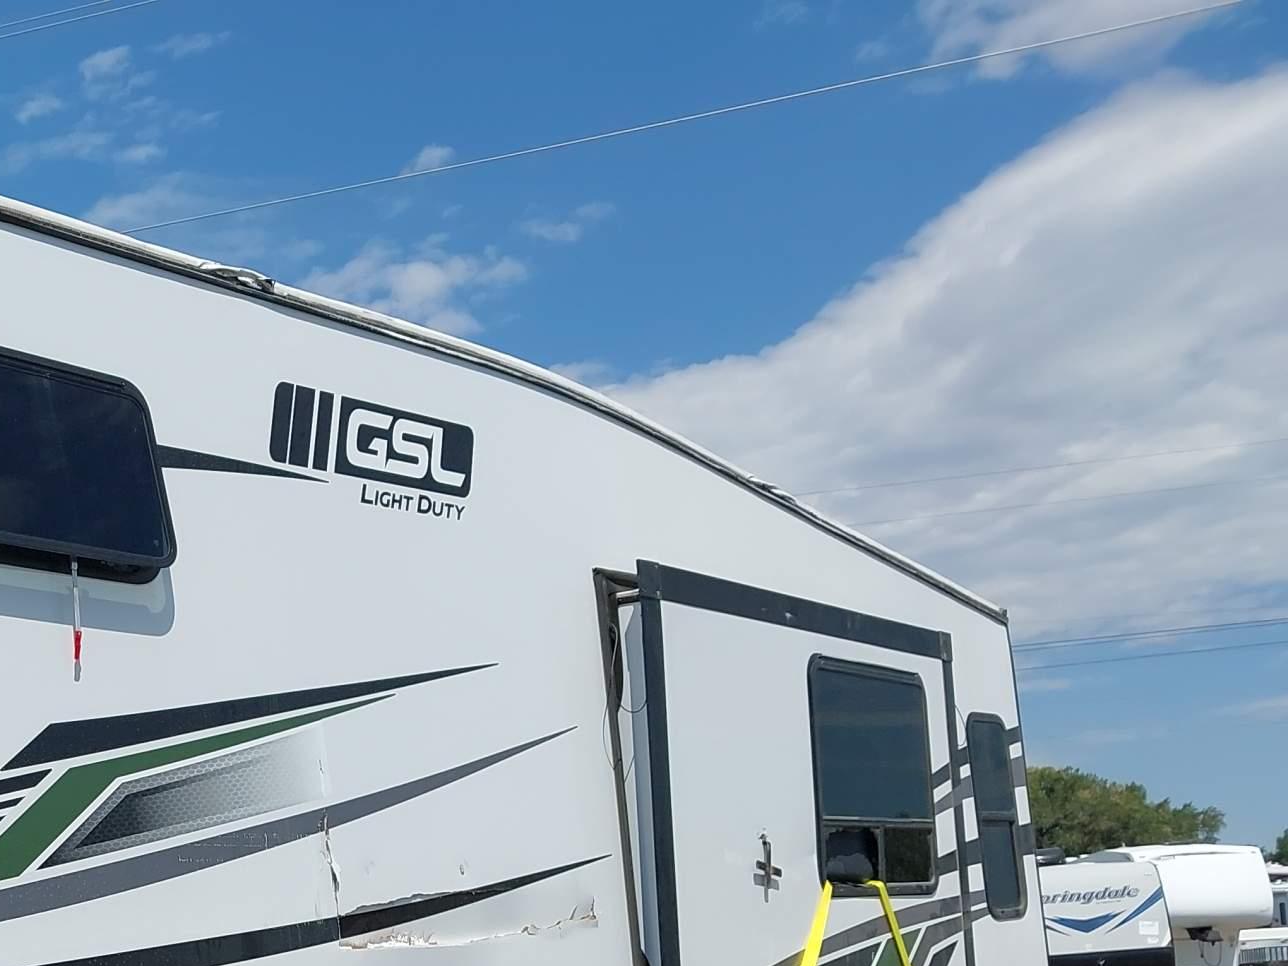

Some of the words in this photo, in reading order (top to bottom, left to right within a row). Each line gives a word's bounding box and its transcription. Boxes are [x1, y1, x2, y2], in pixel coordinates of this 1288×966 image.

[345, 407, 467, 488] GSL
[360, 483, 414, 512] LIGHT
[416, 494, 466, 521] DUTY
